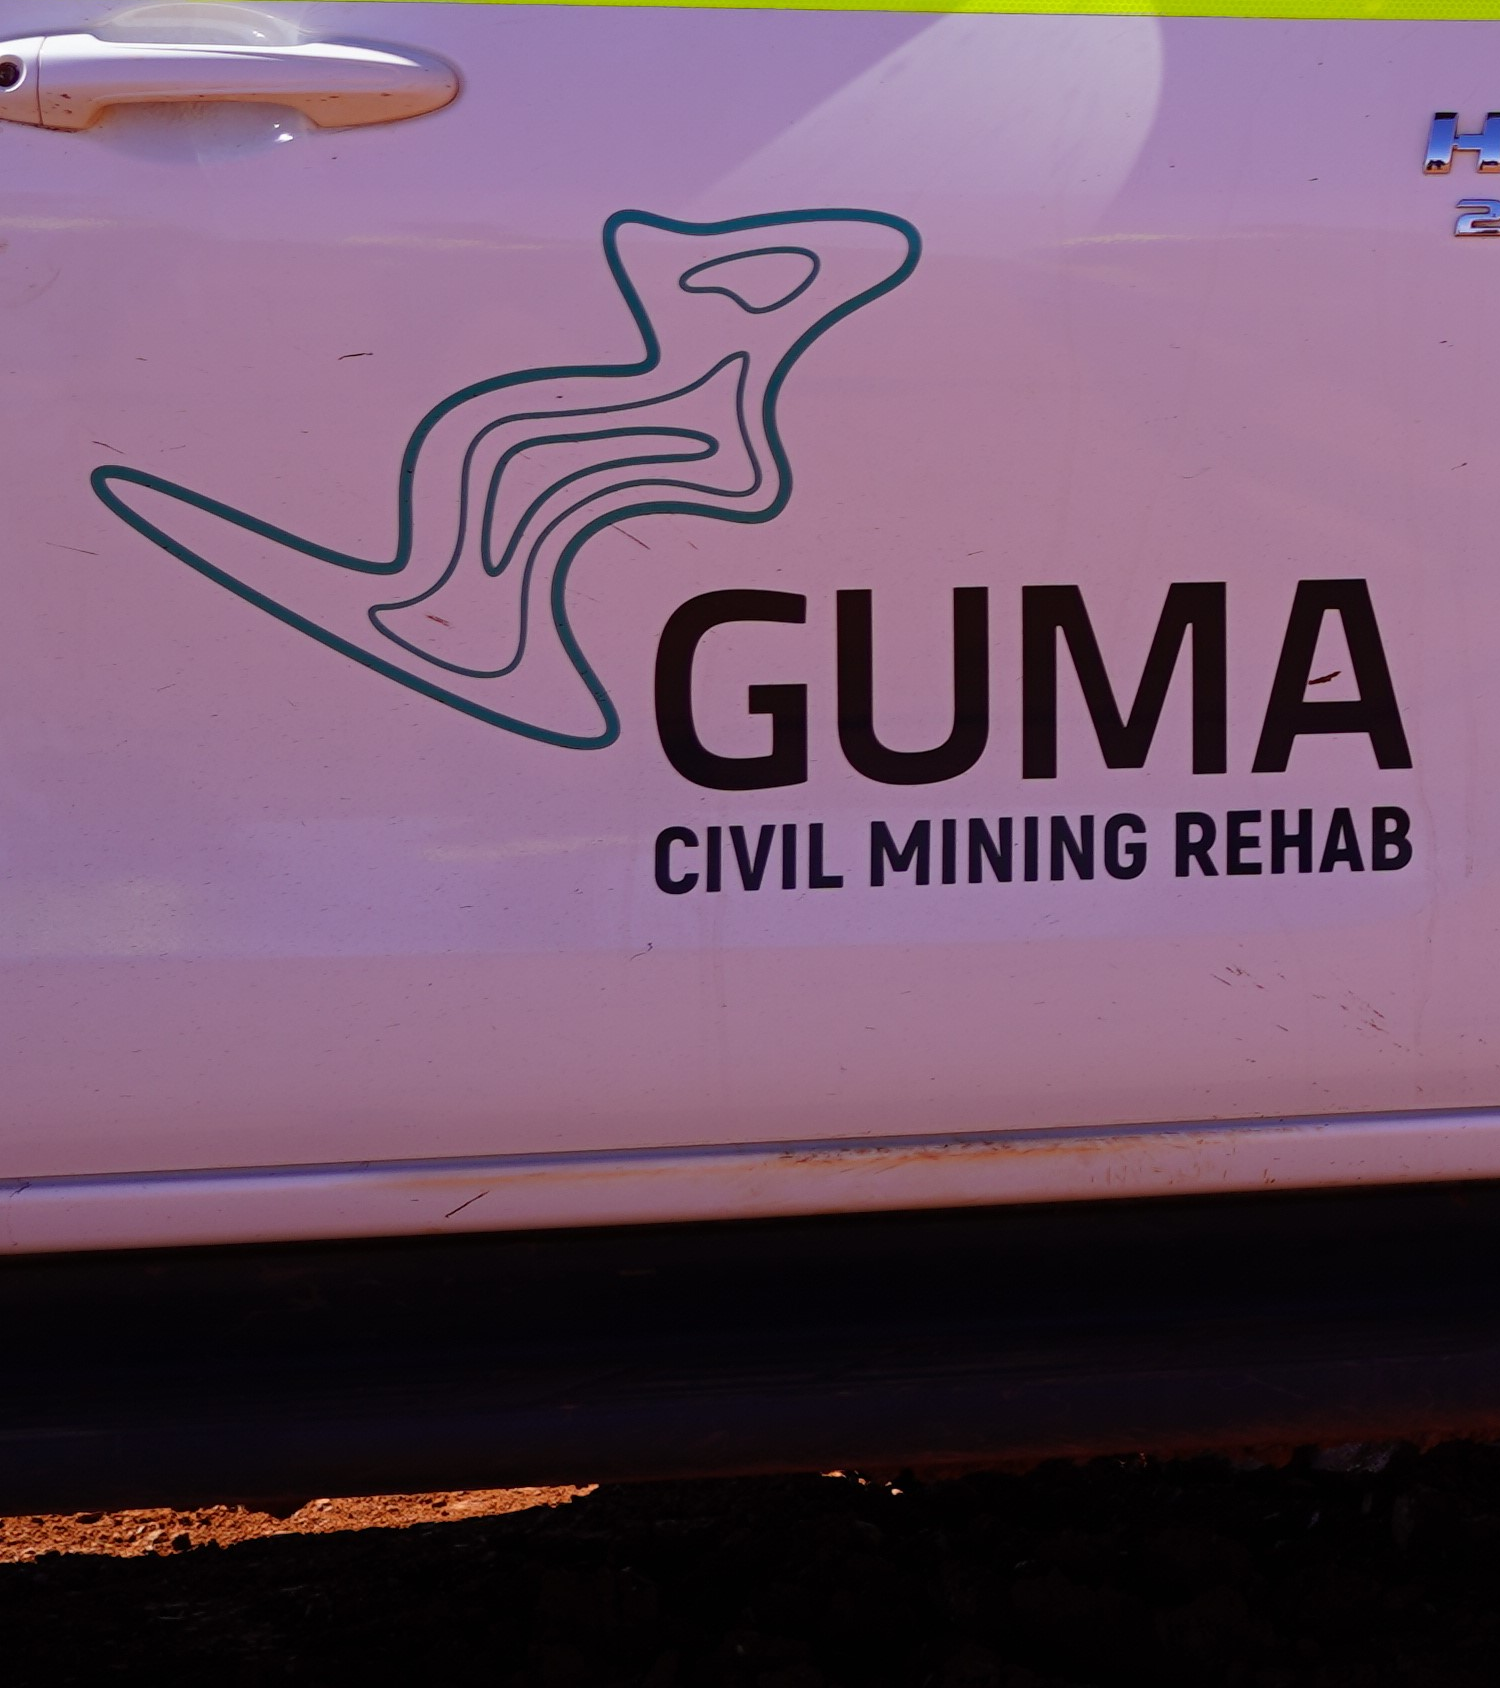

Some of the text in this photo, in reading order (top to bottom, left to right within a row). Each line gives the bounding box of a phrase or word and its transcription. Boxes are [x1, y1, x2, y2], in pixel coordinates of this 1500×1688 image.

[654, 578, 1414, 791] GUMA
[654, 806, 1414, 895] CIVIL MINING REHAB
